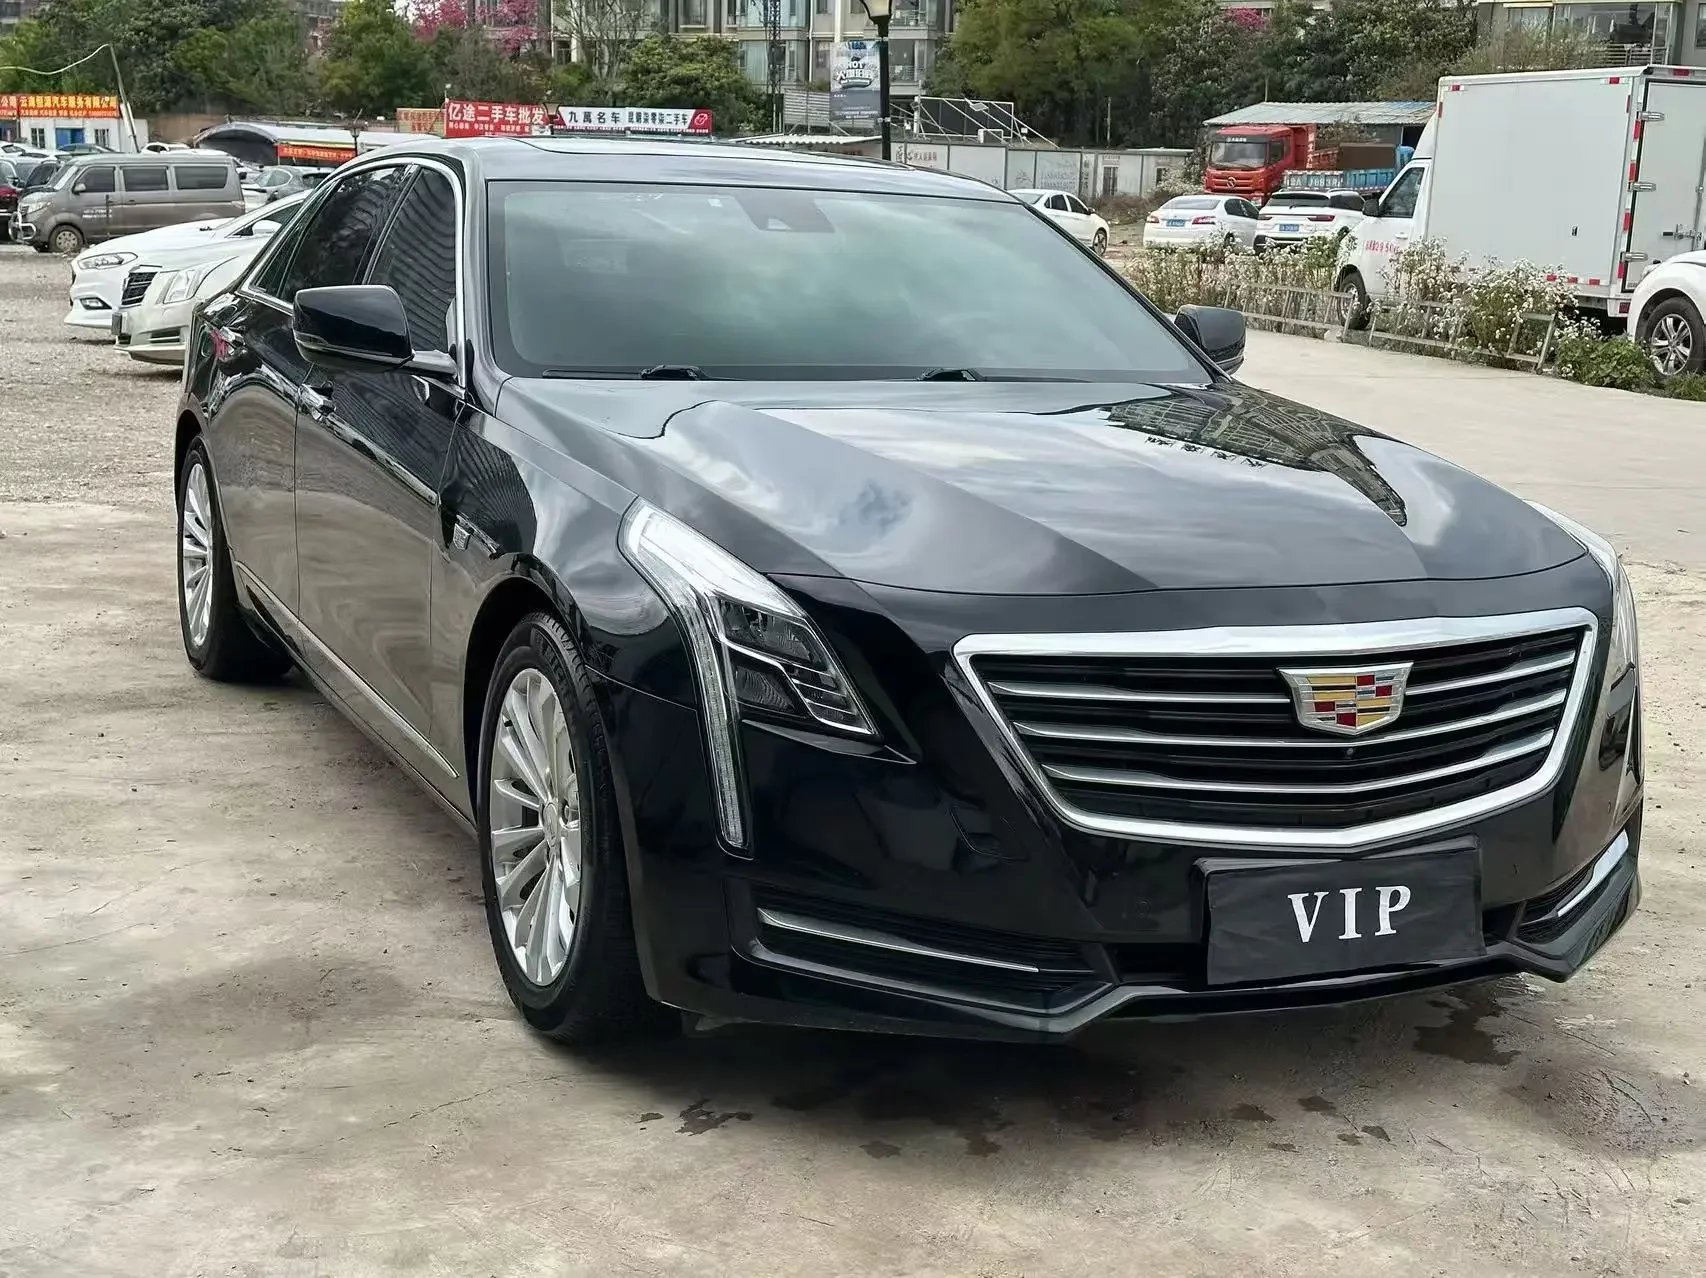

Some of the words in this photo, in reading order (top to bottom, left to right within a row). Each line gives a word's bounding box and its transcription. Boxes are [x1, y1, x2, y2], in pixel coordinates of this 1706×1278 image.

[448, 102, 545, 124] 亿途二手车批发
[1287, 885, 1411, 942] VIP
